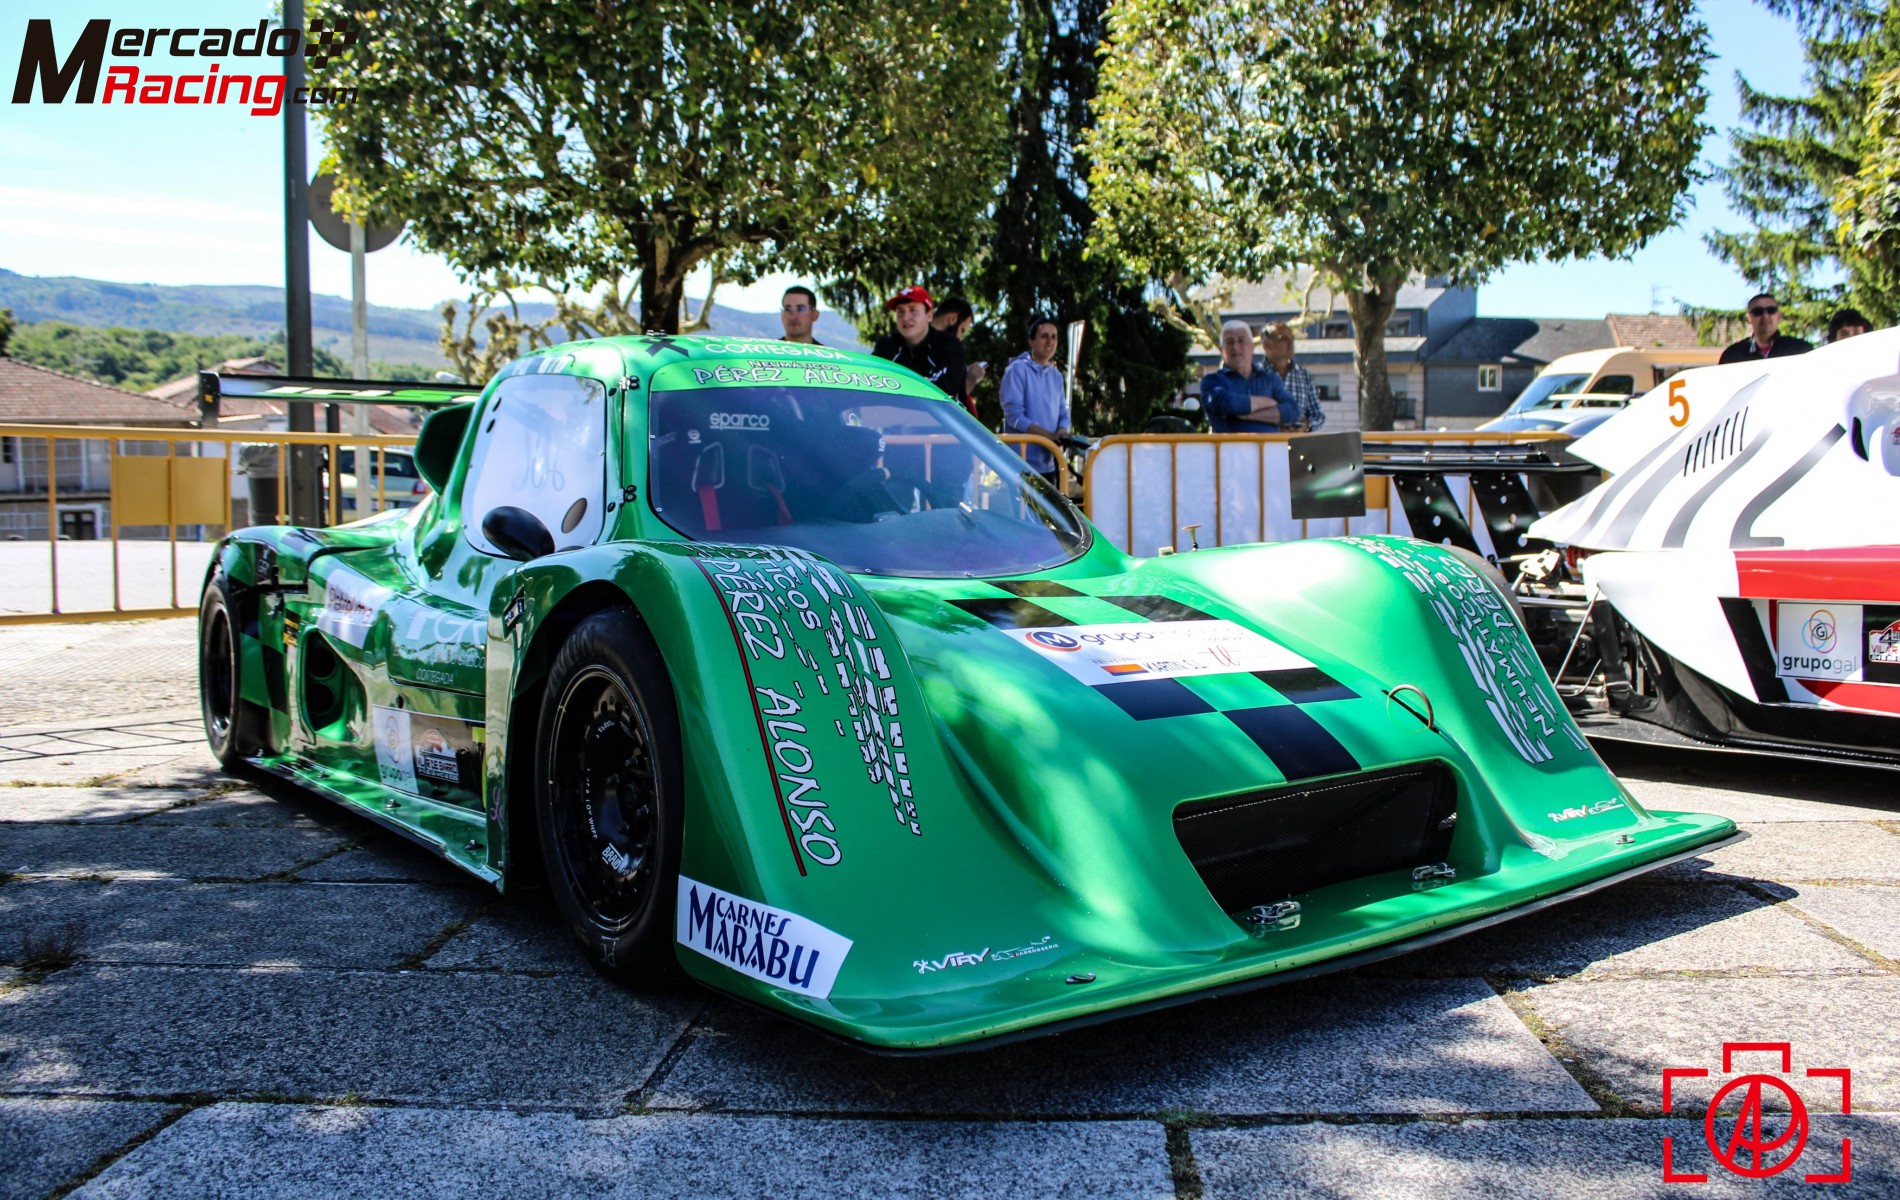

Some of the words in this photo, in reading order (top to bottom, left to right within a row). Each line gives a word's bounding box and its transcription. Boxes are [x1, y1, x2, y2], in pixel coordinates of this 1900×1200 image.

[705, 343, 853, 361] CORTEGADA
[692, 365, 788, 384] PÉREZ
[804, 368, 901, 389] ALONSO
[1668, 379, 1690, 427] 5
[709, 412, 770, 430] sparco
[1079, 631, 1154, 645] grupo
[1782, 654, 1857, 674] grupogal
[699, 557, 786, 660] PÉREZ
[754, 685, 842, 866] ALONSO
[601, 846, 623, 871] BRAID
[716, 897, 792, 937] CARNES
[688, 884, 820, 989] MARABU
